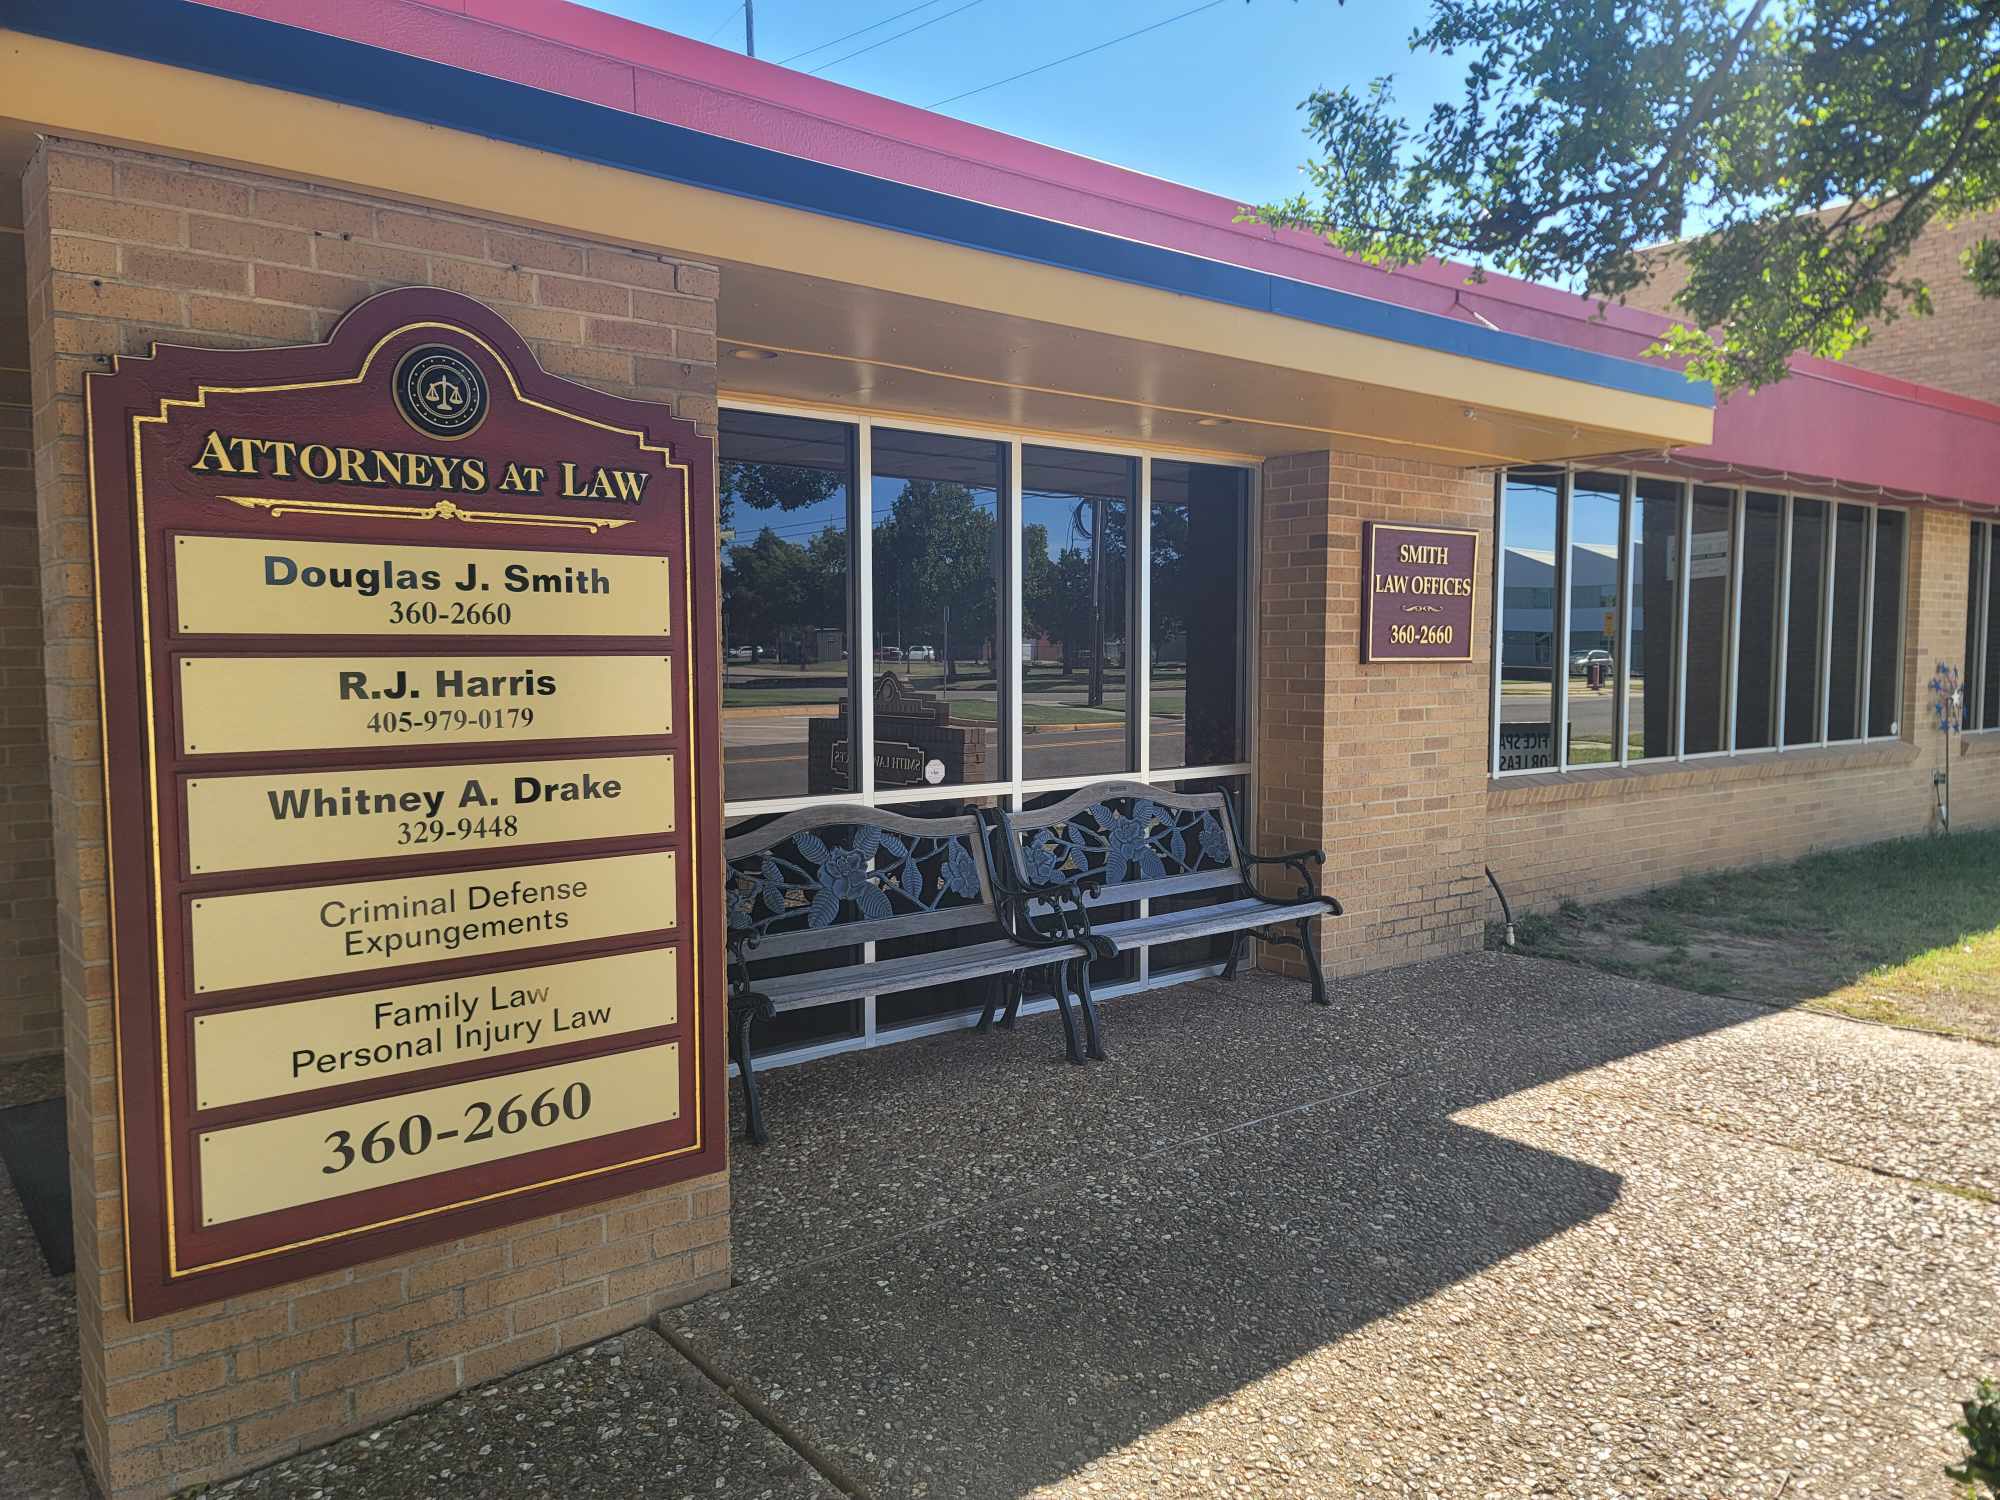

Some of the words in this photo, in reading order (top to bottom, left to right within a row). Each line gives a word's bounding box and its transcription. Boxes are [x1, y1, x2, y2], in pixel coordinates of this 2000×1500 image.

[192, 430, 486, 493] ATTORNEYS
[499, 463, 547, 493] AT
[562, 463, 649, 503] LAW
[1400, 544, 1449, 565] SMITH
[263, 555, 441, 596] Douglas
[454, 563, 490, 592] J.
[504, 564, 611, 595] Smith
[1375, 574, 1409, 594] LAW
[1411, 575, 1471, 597] OFFICES
[389, 600, 512, 627] 360-2660
[1390, 624, 1453, 644] 360-2660
[339, 671, 420, 700] R.J.
[435, 668, 557, 699] Harris
[367, 708, 534, 734] 405-979-0179
[267, 787, 445, 821] Whitney
[458, 779, 498, 808] A.
[513, 774, 622, 804] Drake
[397, 815, 519, 846] 329-9448
[320, 889, 456, 928] Criminal
[468, 878, 588, 911] Defense
[344, 908, 569, 958] Expungements
[374, 992, 479, 1030] Family
[491, 984, 550, 1011] Law
[291, 1030, 442, 1079] Personal
[455, 1014, 542, 1050] Injury
[553, 1004, 612, 1034] Law
[321, 1081, 592, 1175] 360-2660
